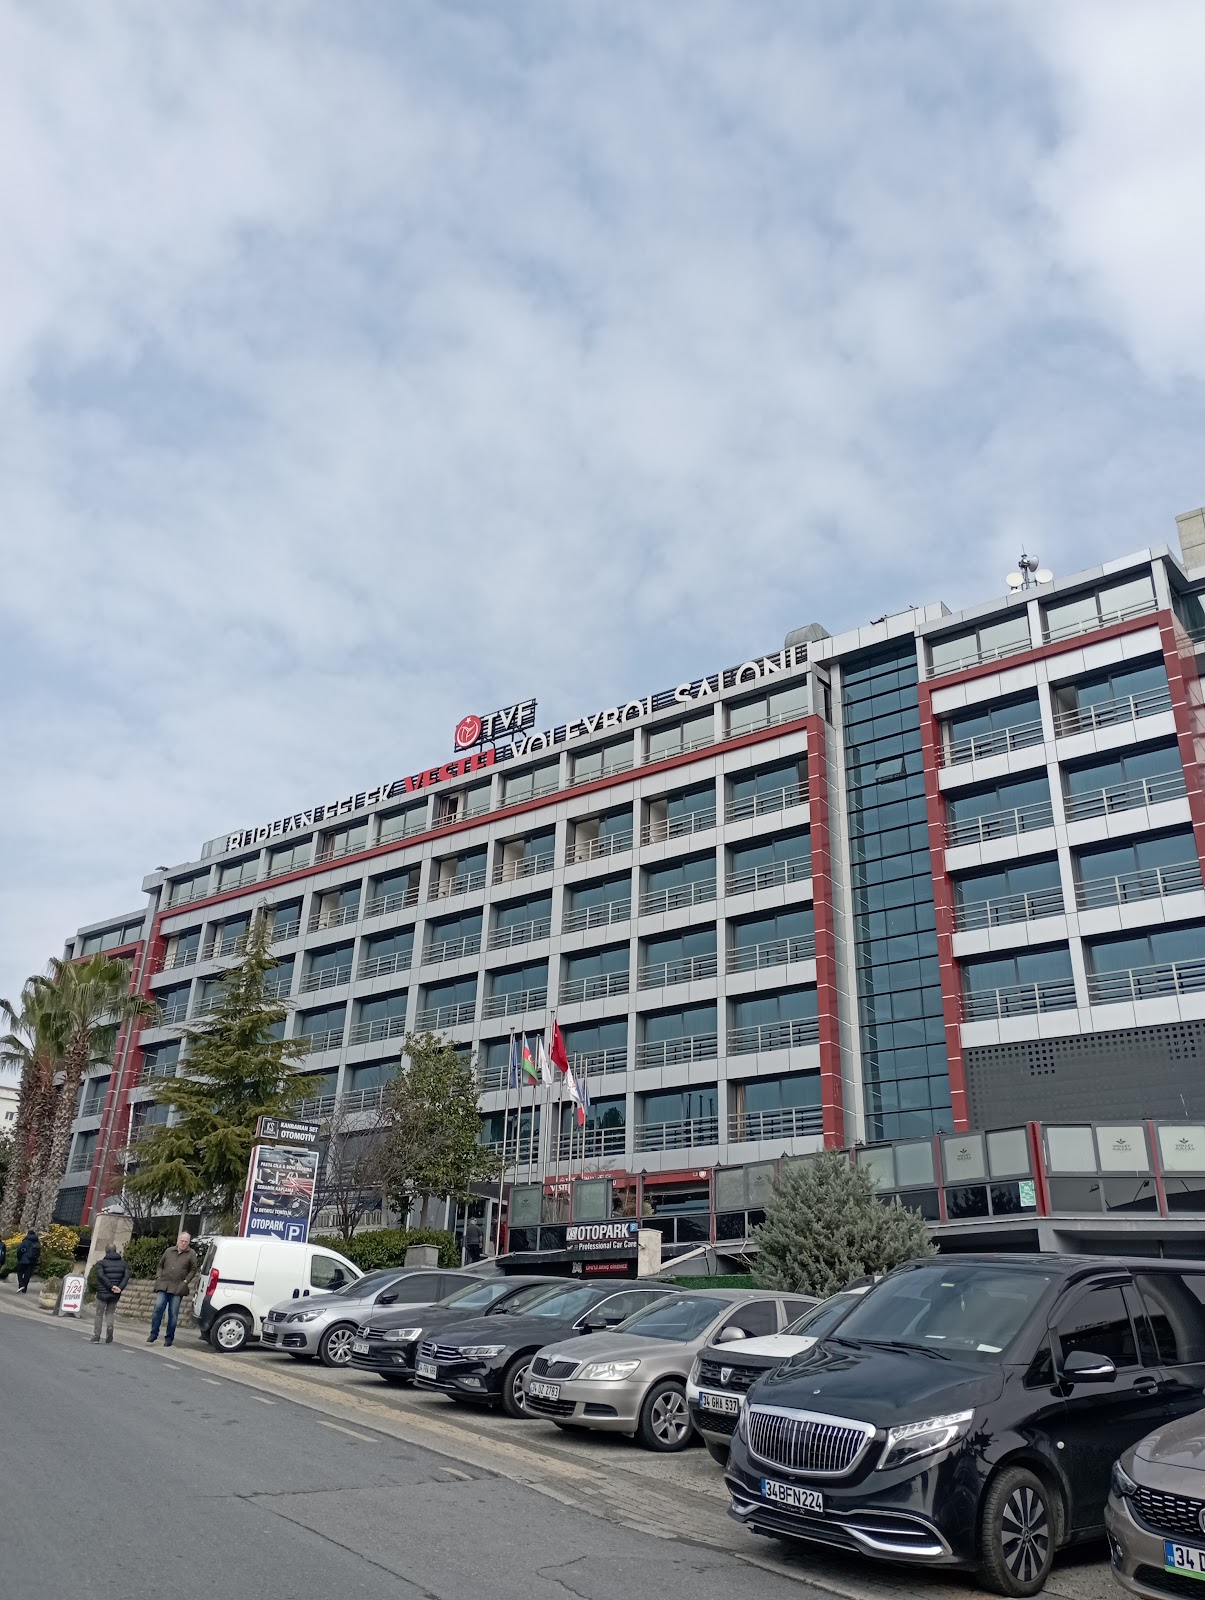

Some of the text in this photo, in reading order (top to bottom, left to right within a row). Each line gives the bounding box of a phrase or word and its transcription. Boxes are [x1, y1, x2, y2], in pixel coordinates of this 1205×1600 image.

[484, 700, 532, 736] TVF
[281, 1130, 316, 1142] OTOMOTİV
[251, 1218, 300, 1240] OTOPARK P
[578, 1224, 630, 1240] OTOPARK
[579, 1241, 611, 1250] Professional
[66, 1286, 82, 1294] 7/24
[704, 1396, 710, 1406] 34
[725, 1399, 736, 1411] 537
[1176, 1547, 1194, 1569] 34
